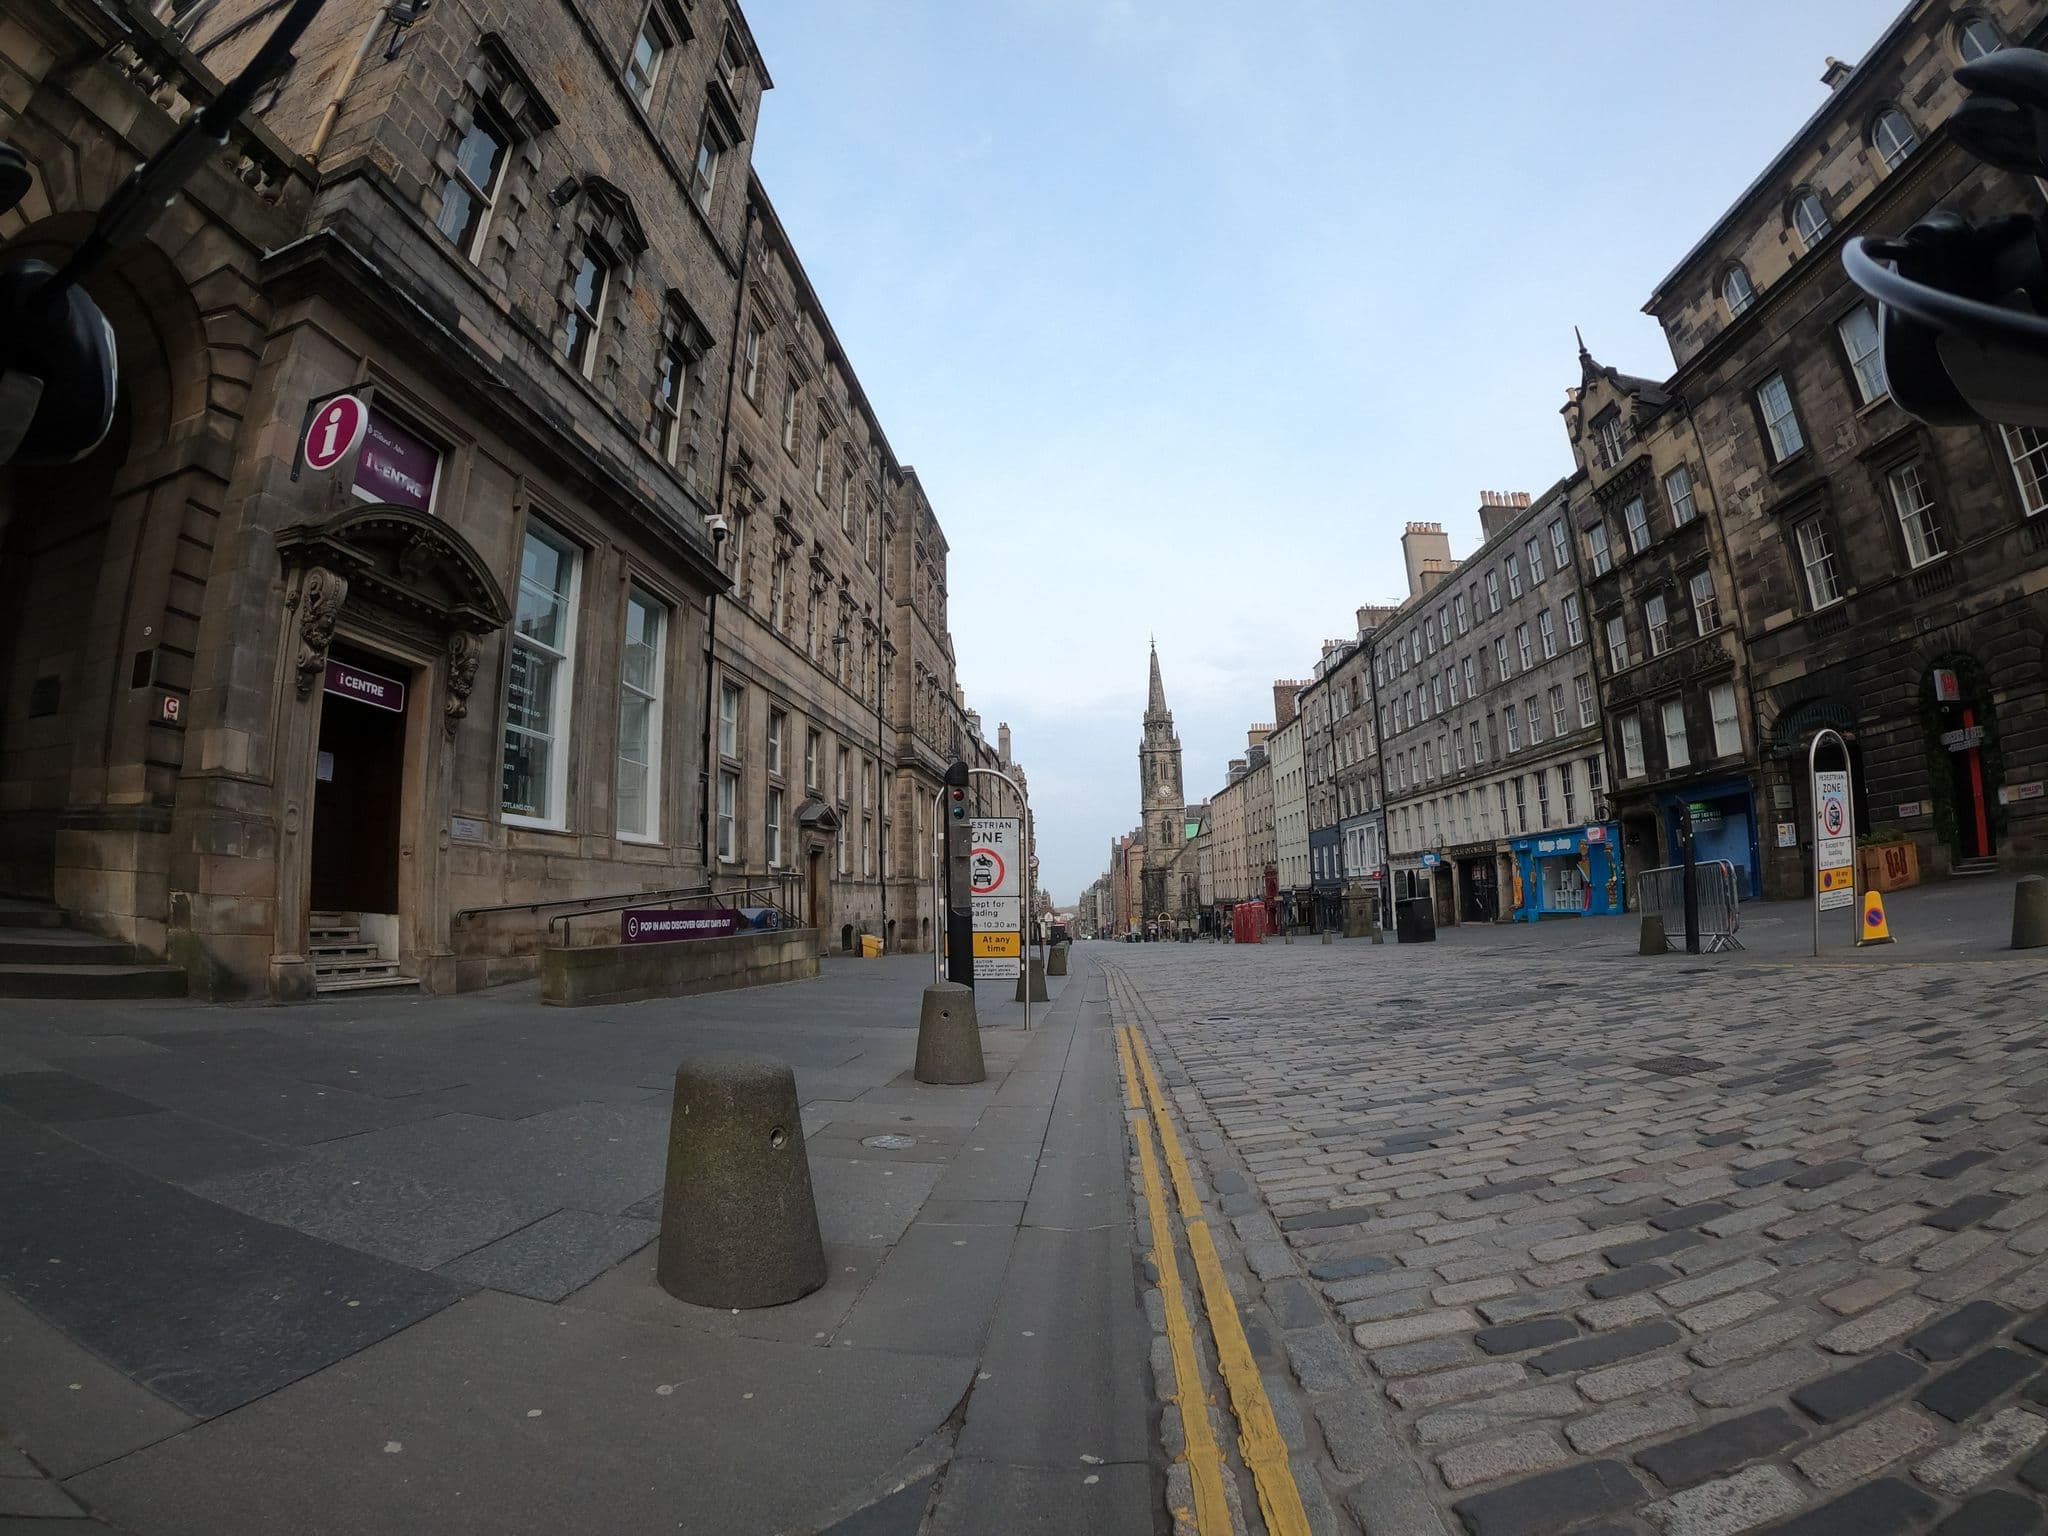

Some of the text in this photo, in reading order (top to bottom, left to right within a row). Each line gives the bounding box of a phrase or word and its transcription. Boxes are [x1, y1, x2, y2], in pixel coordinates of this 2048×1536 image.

[374, 464, 422, 498] CENTRE
[345, 676, 384, 697] CENTRE
[167, 699, 178, 714] G
[1823, 783, 1841, 793] ZONE
[971, 821, 1012, 829] ESTRIAN
[970, 832, 1003, 843] ONE
[970, 901, 990, 910] cept
[973, 909, 998, 918] ading
[640, 918, 731, 932] POP IN AND DISCOVER GREAT DAYS OUT
[995, 937, 1010, 945] any
